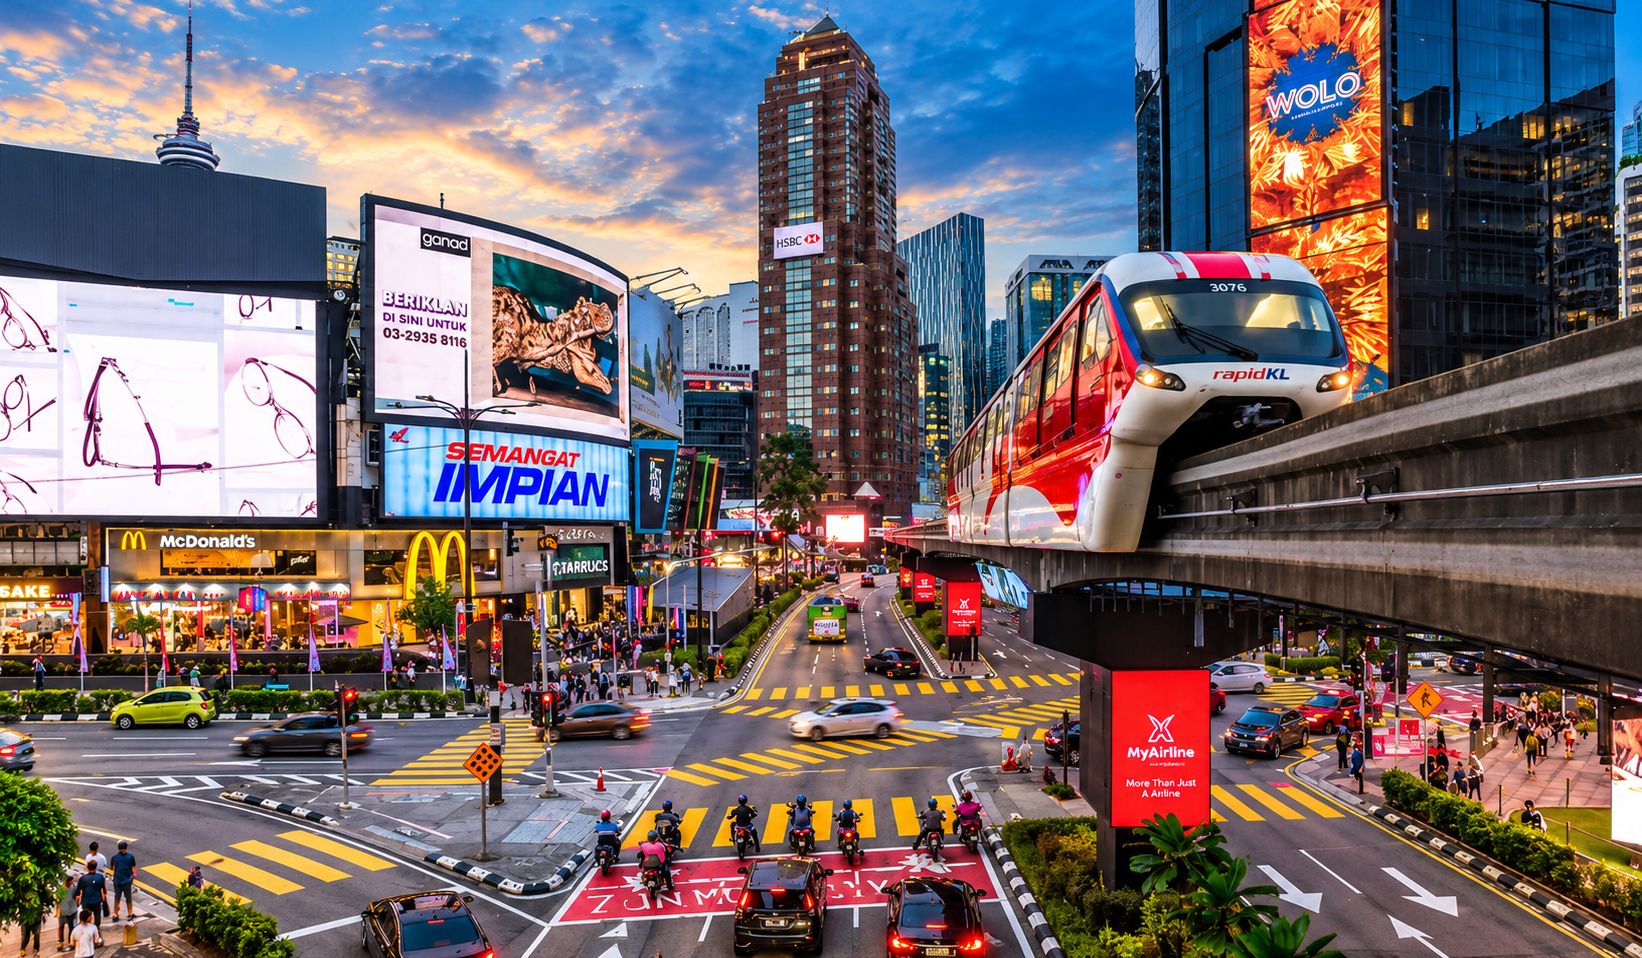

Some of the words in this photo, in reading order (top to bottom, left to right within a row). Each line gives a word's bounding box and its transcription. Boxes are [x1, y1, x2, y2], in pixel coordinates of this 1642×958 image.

[1266, 72, 1361, 118] WOLO
[422, 233, 469, 250] ganad
[776, 236, 802, 248] HSBC
[1209, 283, 1247, 292] 3076
[382, 289, 468, 317] BERIKLAN
[383, 312, 395, 322] DI
[399, 314, 423, 326] SINI
[427, 317, 467, 332] UNTUK
[383, 327, 437, 344] 03-2935
[440, 335, 467, 348] 8116
[1213, 367, 1290, 382] rapidKL
[445, 441, 581, 468] SEMANGAT
[433, 462, 610, 507] IMPIAN
[160, 534, 256, 548] McDonald's
[1127, 746, 1195, 761] MyAirline
[1126, 779, 1151, 787] More
[1152, 779, 1175, 787] Than
[1177, 778, 1197, 787] Just
[1141, 789, 1149, 798] A
